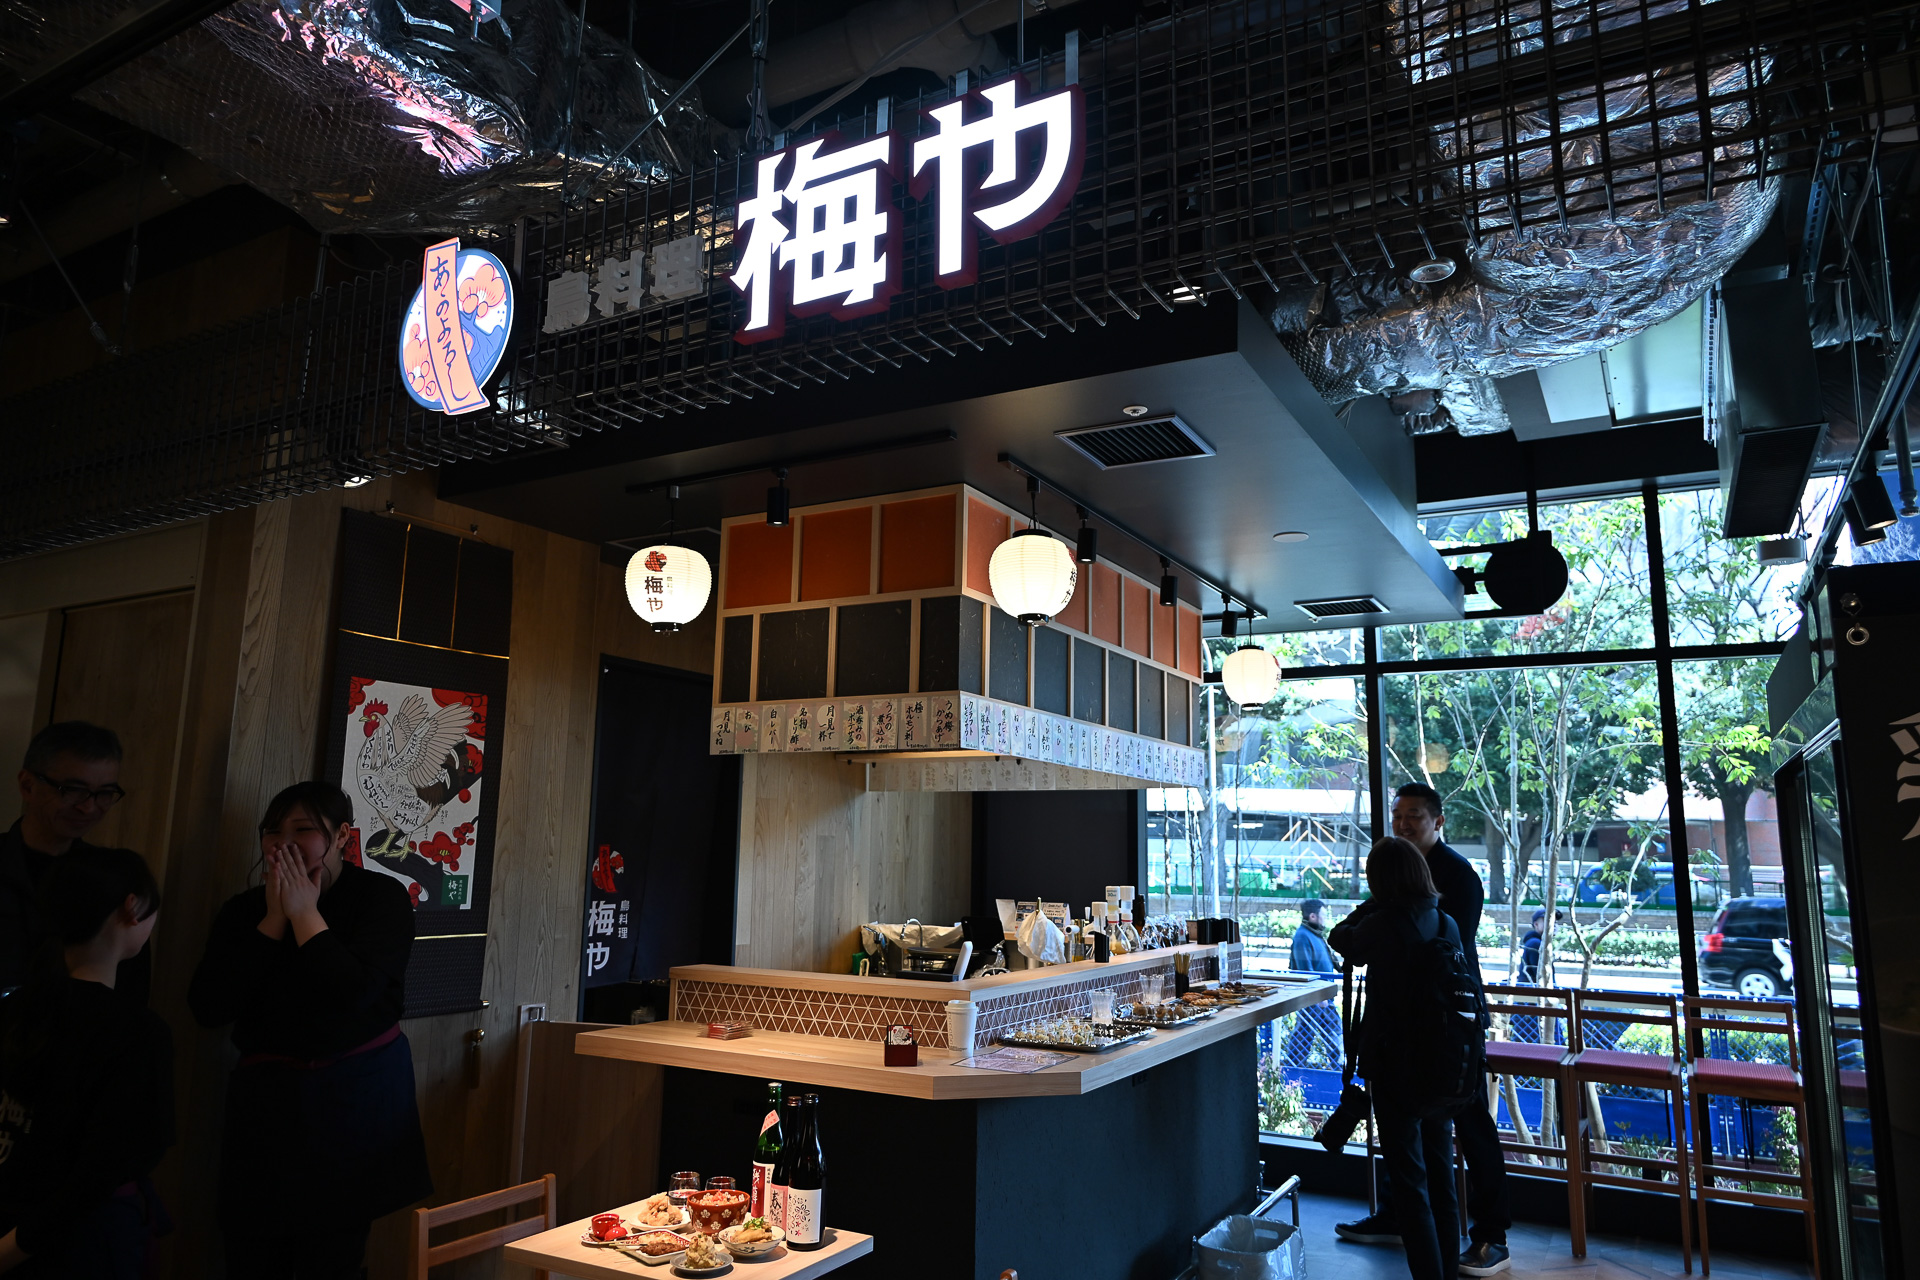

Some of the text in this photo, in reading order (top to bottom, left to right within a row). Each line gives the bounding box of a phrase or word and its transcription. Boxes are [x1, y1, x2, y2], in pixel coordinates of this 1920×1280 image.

[730, 79, 1071, 331] 梅や
[430, 256, 471, 401] あのよろし
[645, 576, 663, 612] 梅や
[722, 710, 731, 734] 月見
[799, 707, 808, 729] 名物
[875, 713, 885, 744] 煮込み
[884, 702, 892, 731] うちの
[715, 724, 723, 746] つくね
[362, 737, 375, 769] くびかわ
[448, 880, 459, 901] 梅や
[618, 899, 630, 939] 鳥料理
[586, 900, 617, 977] 梅や
